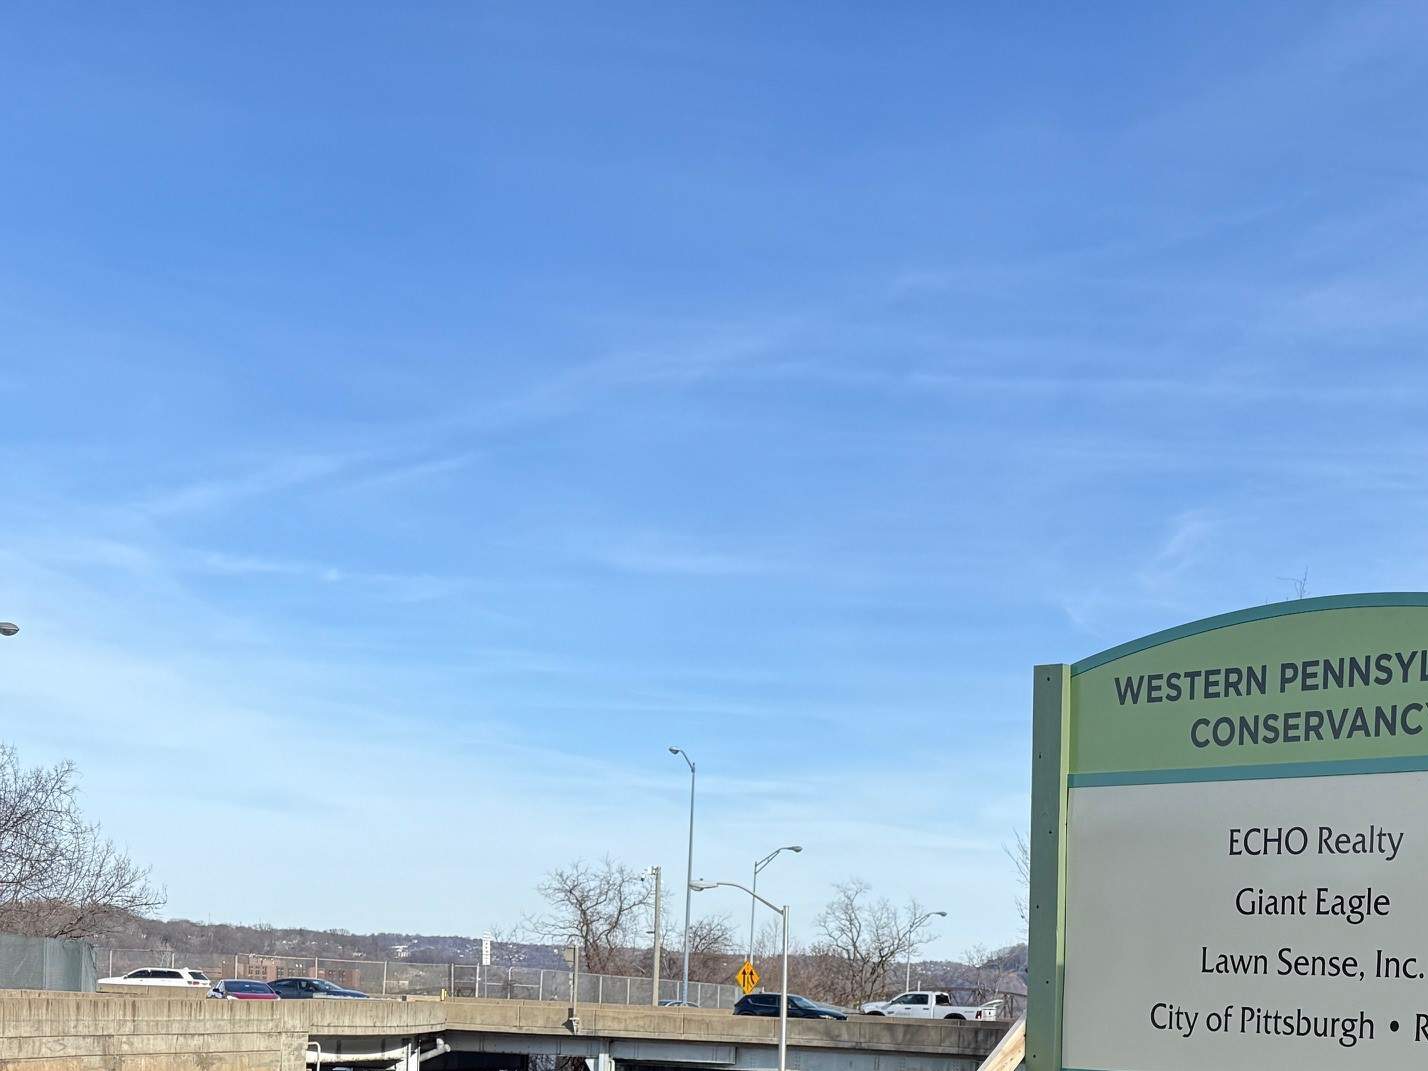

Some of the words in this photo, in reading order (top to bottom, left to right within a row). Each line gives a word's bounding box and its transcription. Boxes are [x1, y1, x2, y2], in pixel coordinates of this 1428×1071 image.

[1114, 664, 1268, 706] WESTERN
[1228, 826, 1309, 856] ECHO
[1317, 825, 1404, 861] Realty
[1235, 887, 1308, 916] Giant
[1315, 887, 1391, 925] Eagle
[1201, 946, 1269, 975] Lawn
[1276, 947, 1366, 982] Sense,
[1374, 949, 1425, 979] Inc.
[1150, 1002, 1199, 1038] City
[1206, 1005, 1234, 1033] of
[1240, 1006, 1375, 1048] Pittsburgh
